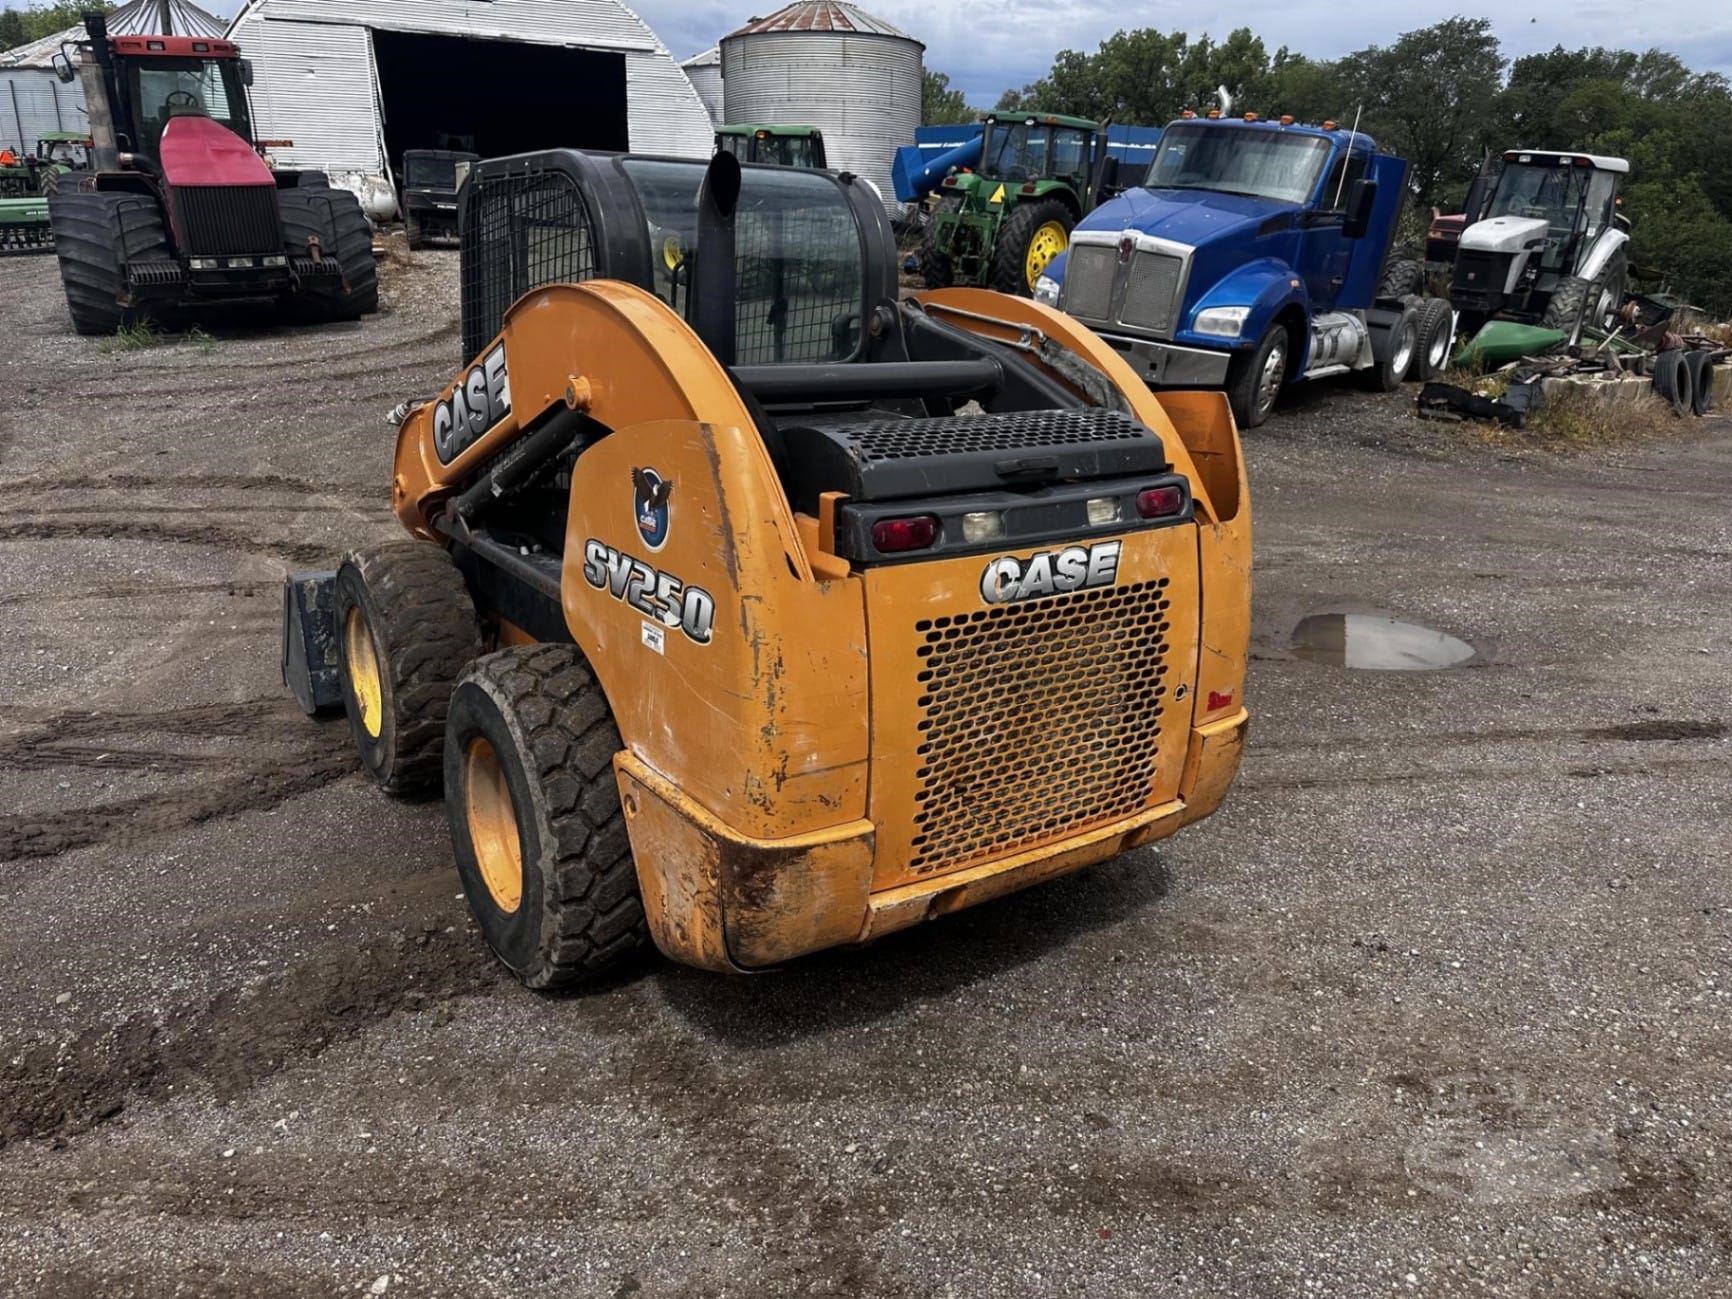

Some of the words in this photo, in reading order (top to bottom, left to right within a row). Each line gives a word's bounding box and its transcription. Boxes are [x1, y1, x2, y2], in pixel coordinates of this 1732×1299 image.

[433, 340, 510, 465] CASE
[584, 538, 715, 643] SV250
[980, 540, 1121, 604] CASE
